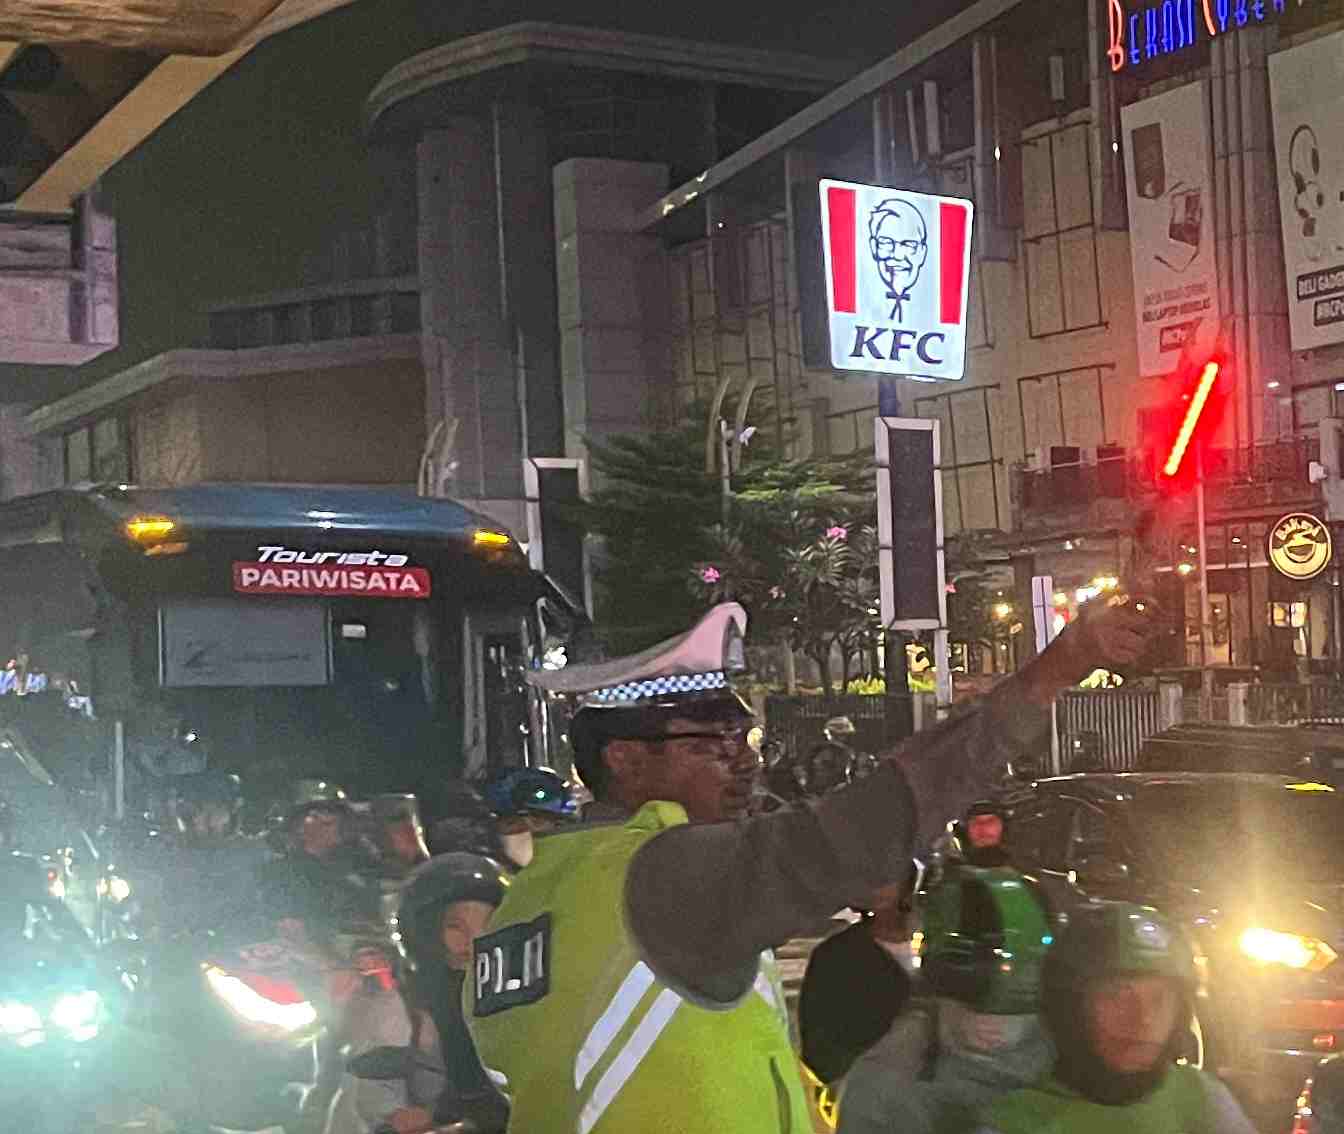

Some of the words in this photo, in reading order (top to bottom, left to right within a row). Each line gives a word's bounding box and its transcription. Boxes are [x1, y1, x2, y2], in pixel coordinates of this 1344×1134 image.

[848, 325, 945, 364] KFC
[258, 546, 409, 567] Tourista
[241, 568, 421, 592] PARIWISATA
